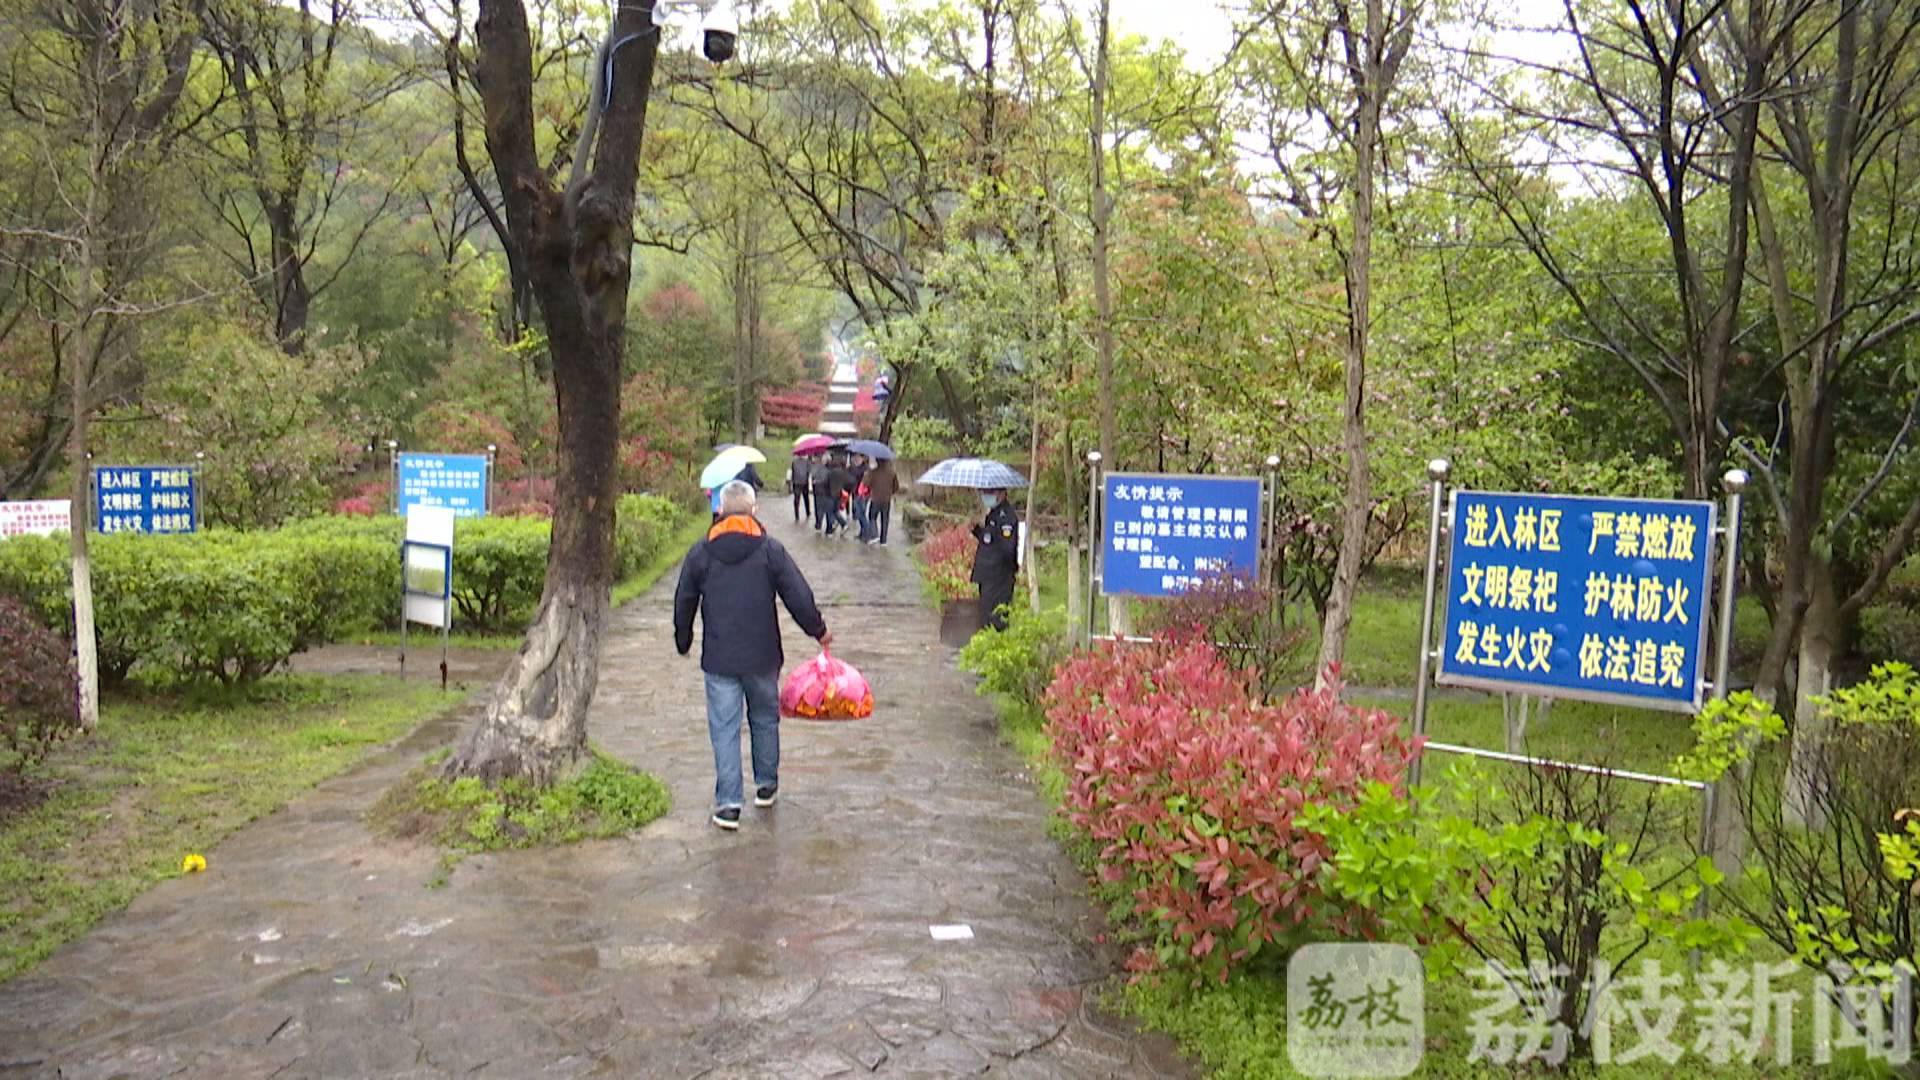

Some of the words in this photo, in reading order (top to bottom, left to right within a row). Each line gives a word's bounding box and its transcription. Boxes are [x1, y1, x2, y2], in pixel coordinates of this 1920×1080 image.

[1113, 484, 1184, 502] 友情提示
[1464, 503, 1563, 551] 进入林区
[1588, 511, 1697, 561] 严禁燃放
[1460, 561, 1558, 612] 文明祭祀
[1584, 570, 1690, 625] 护林防火
[1455, 619, 1554, 673] 发生火灾
[1579, 632, 1686, 688] 依法追究
